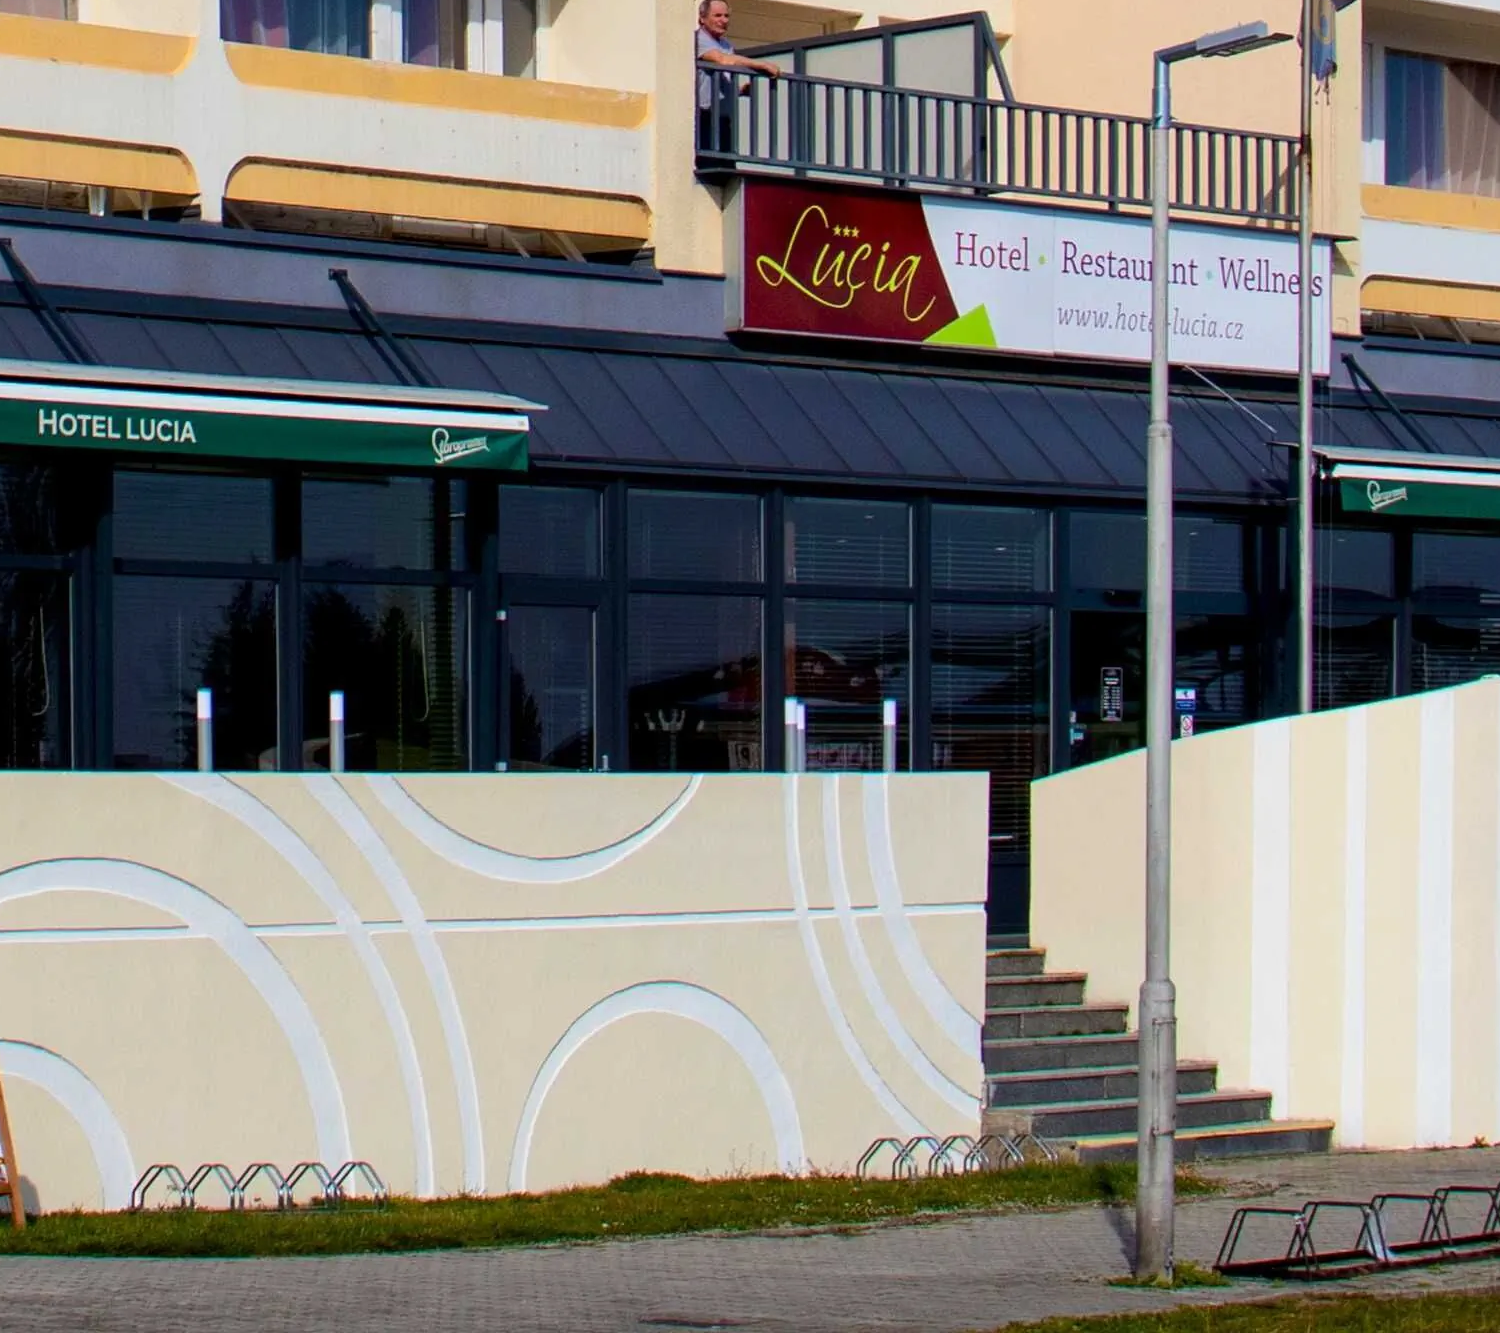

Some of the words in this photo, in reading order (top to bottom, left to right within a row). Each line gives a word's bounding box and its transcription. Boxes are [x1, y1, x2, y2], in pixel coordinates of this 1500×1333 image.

[756, 204, 937, 323] Lucia
[955, 231, 1031, 272] Hotel
[1061, 240, 1199, 287] Restaunt
[1218, 256, 1324, 298] Wellnes
[1057, 301, 1245, 340] www.hot-lucia.cz
[38, 408, 121, 440] HOTEL
[125, 417, 197, 444] LUCIA
